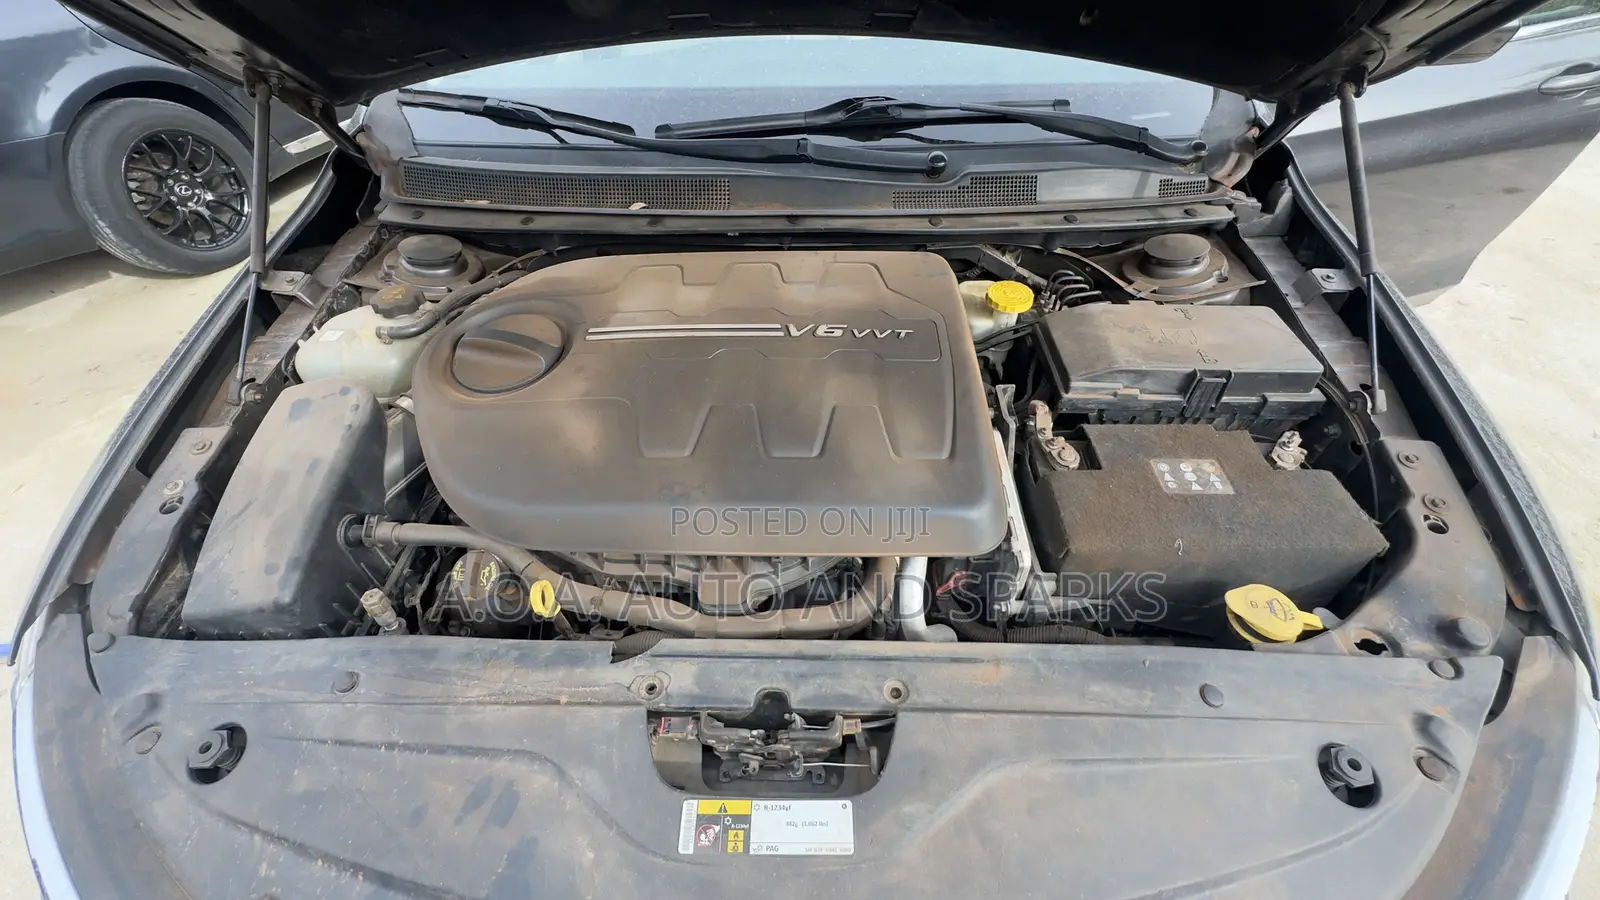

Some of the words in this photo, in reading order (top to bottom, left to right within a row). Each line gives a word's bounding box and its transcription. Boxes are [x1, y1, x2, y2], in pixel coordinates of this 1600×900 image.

[786, 323, 848, 338] V6
[851, 328, 914, 339] VVT
[763, 804, 792, 812] R-1234yf
